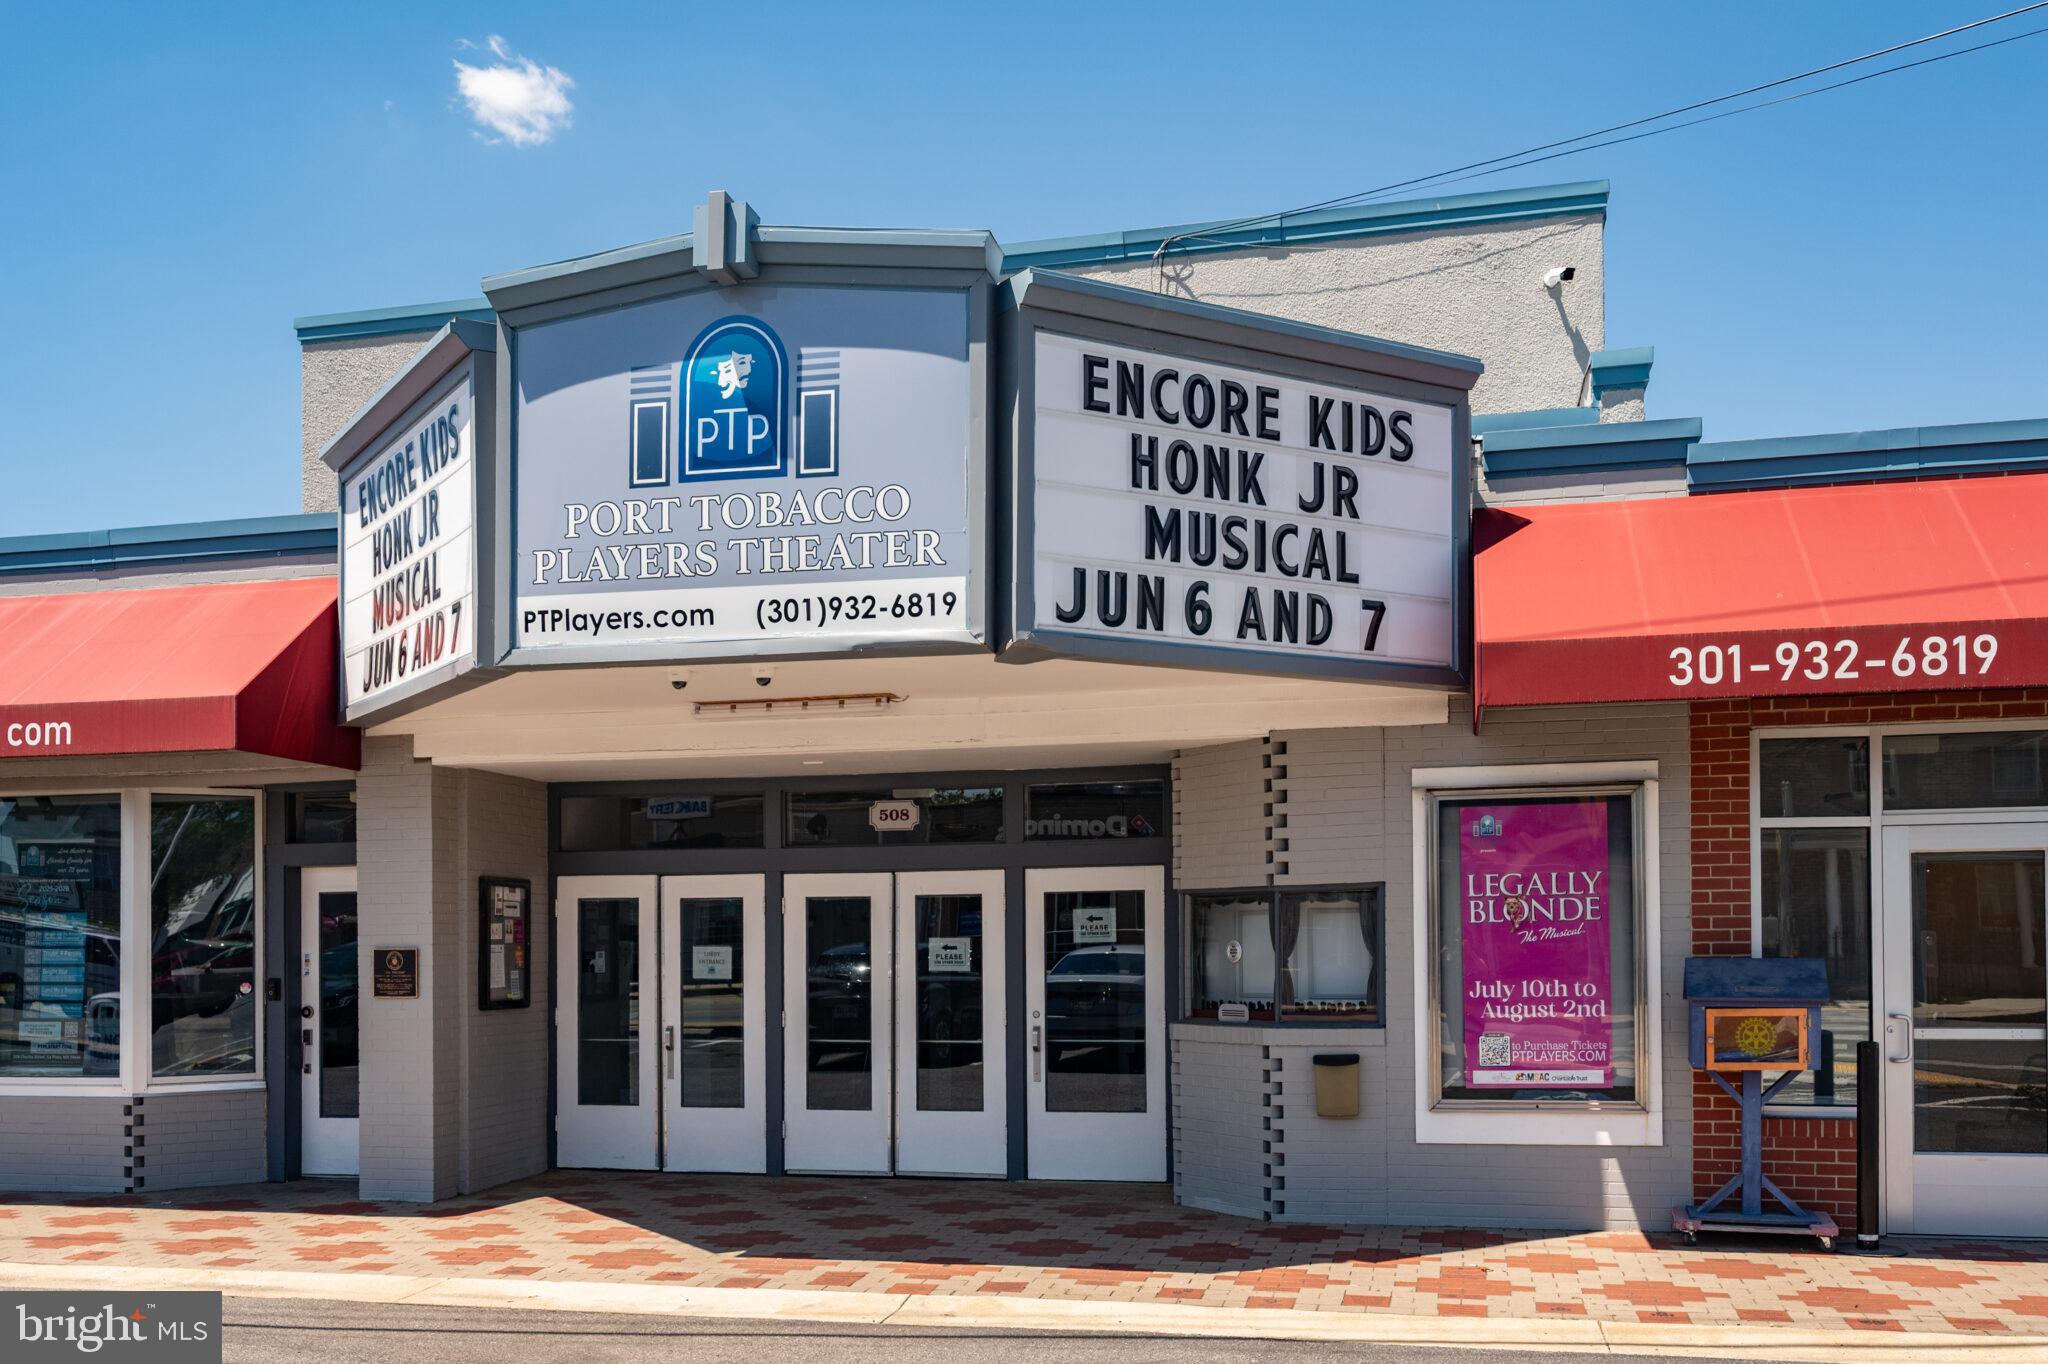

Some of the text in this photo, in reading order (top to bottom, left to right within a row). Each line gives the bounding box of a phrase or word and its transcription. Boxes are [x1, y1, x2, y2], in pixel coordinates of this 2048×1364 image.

[697, 407, 769, 458] PTP
[1083, 353, 1414, 462] ENCORE KIDS
[358, 403, 460, 529] ENCORE KIDS
[1131, 433, 1361, 520] HONK JR
[372, 489, 440, 578] HONK JR
[564, 484, 912, 539] PORT TOBACCO
[532, 529, 947, 585] PLAYERS THEATER
[1144, 504, 1361, 585] MUSICAL
[372, 551, 441, 634] MUSICAL
[524, 591, 958, 636] PTPlayers.com (301)932-6819
[1055, 566, 1387, 652] JUN 6 AND 7
[363, 601, 461, 693] JUN 6 AND 7
[1668, 634, 1998, 686] 301-932-6819
[7, 721, 72, 746] com
[879, 808, 910, 822] 508
[1467, 870, 1602, 897] LEGALLY
[1469, 896, 1602, 924] BLONDE
[1518, 922, 1583, 944] The Musical
[1469, 979, 1597, 1002] July 10th to
[1480, 999, 1606, 1023] August 2nd
[1512, 1040, 1607, 1051] to Purchase Tickets
[1512, 1050, 1606, 1062] PTPLAYERS.COM
